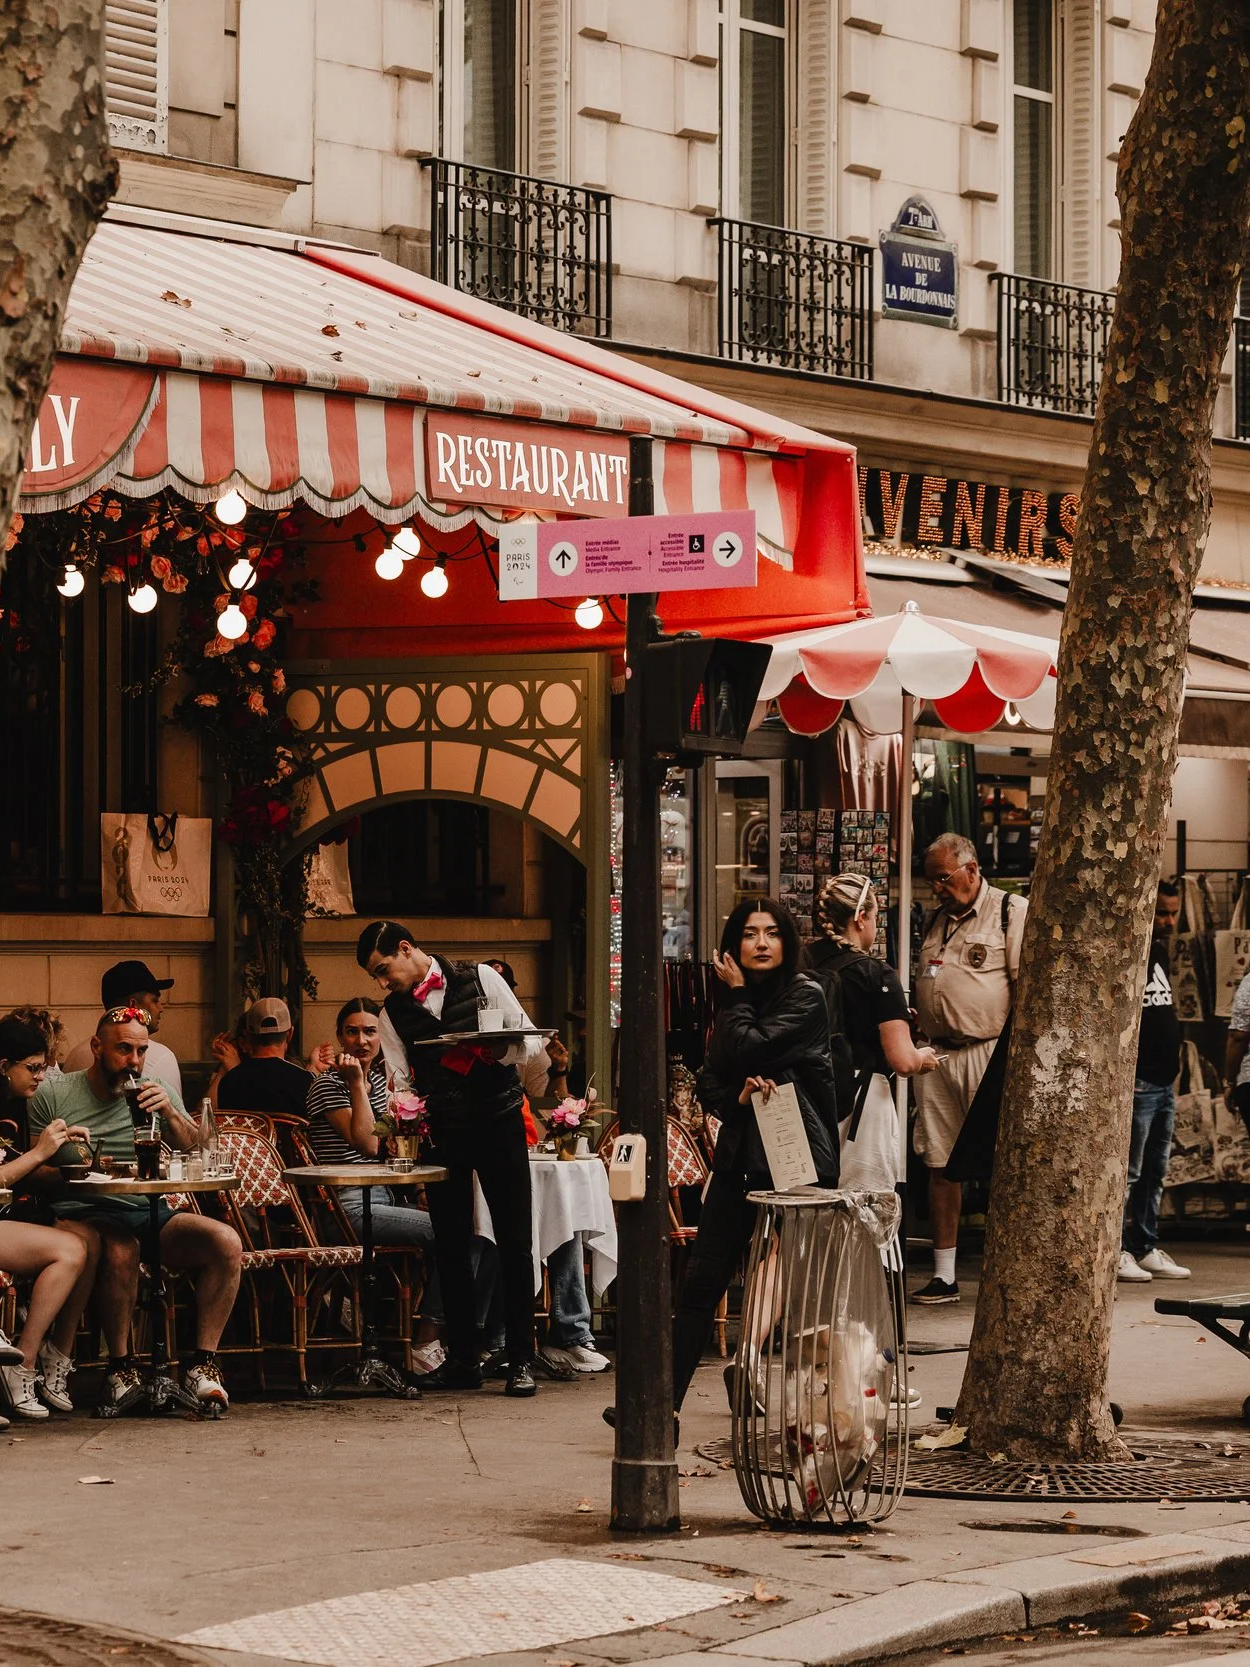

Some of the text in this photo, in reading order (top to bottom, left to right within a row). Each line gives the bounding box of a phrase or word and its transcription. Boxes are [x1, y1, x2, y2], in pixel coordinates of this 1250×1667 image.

[901, 252, 941, 272] AVENUE
[915, 272, 928, 286] DE
[885, 283, 956, 309] LA BOURDONNAIS
[23, 394, 81, 473] LY
[435, 432, 627, 507] RESTAURANT
[506, 553, 530, 562] PARIS
[506, 562, 530, 571] 2024
[148, 875, 189, 884] PARIS 2024
